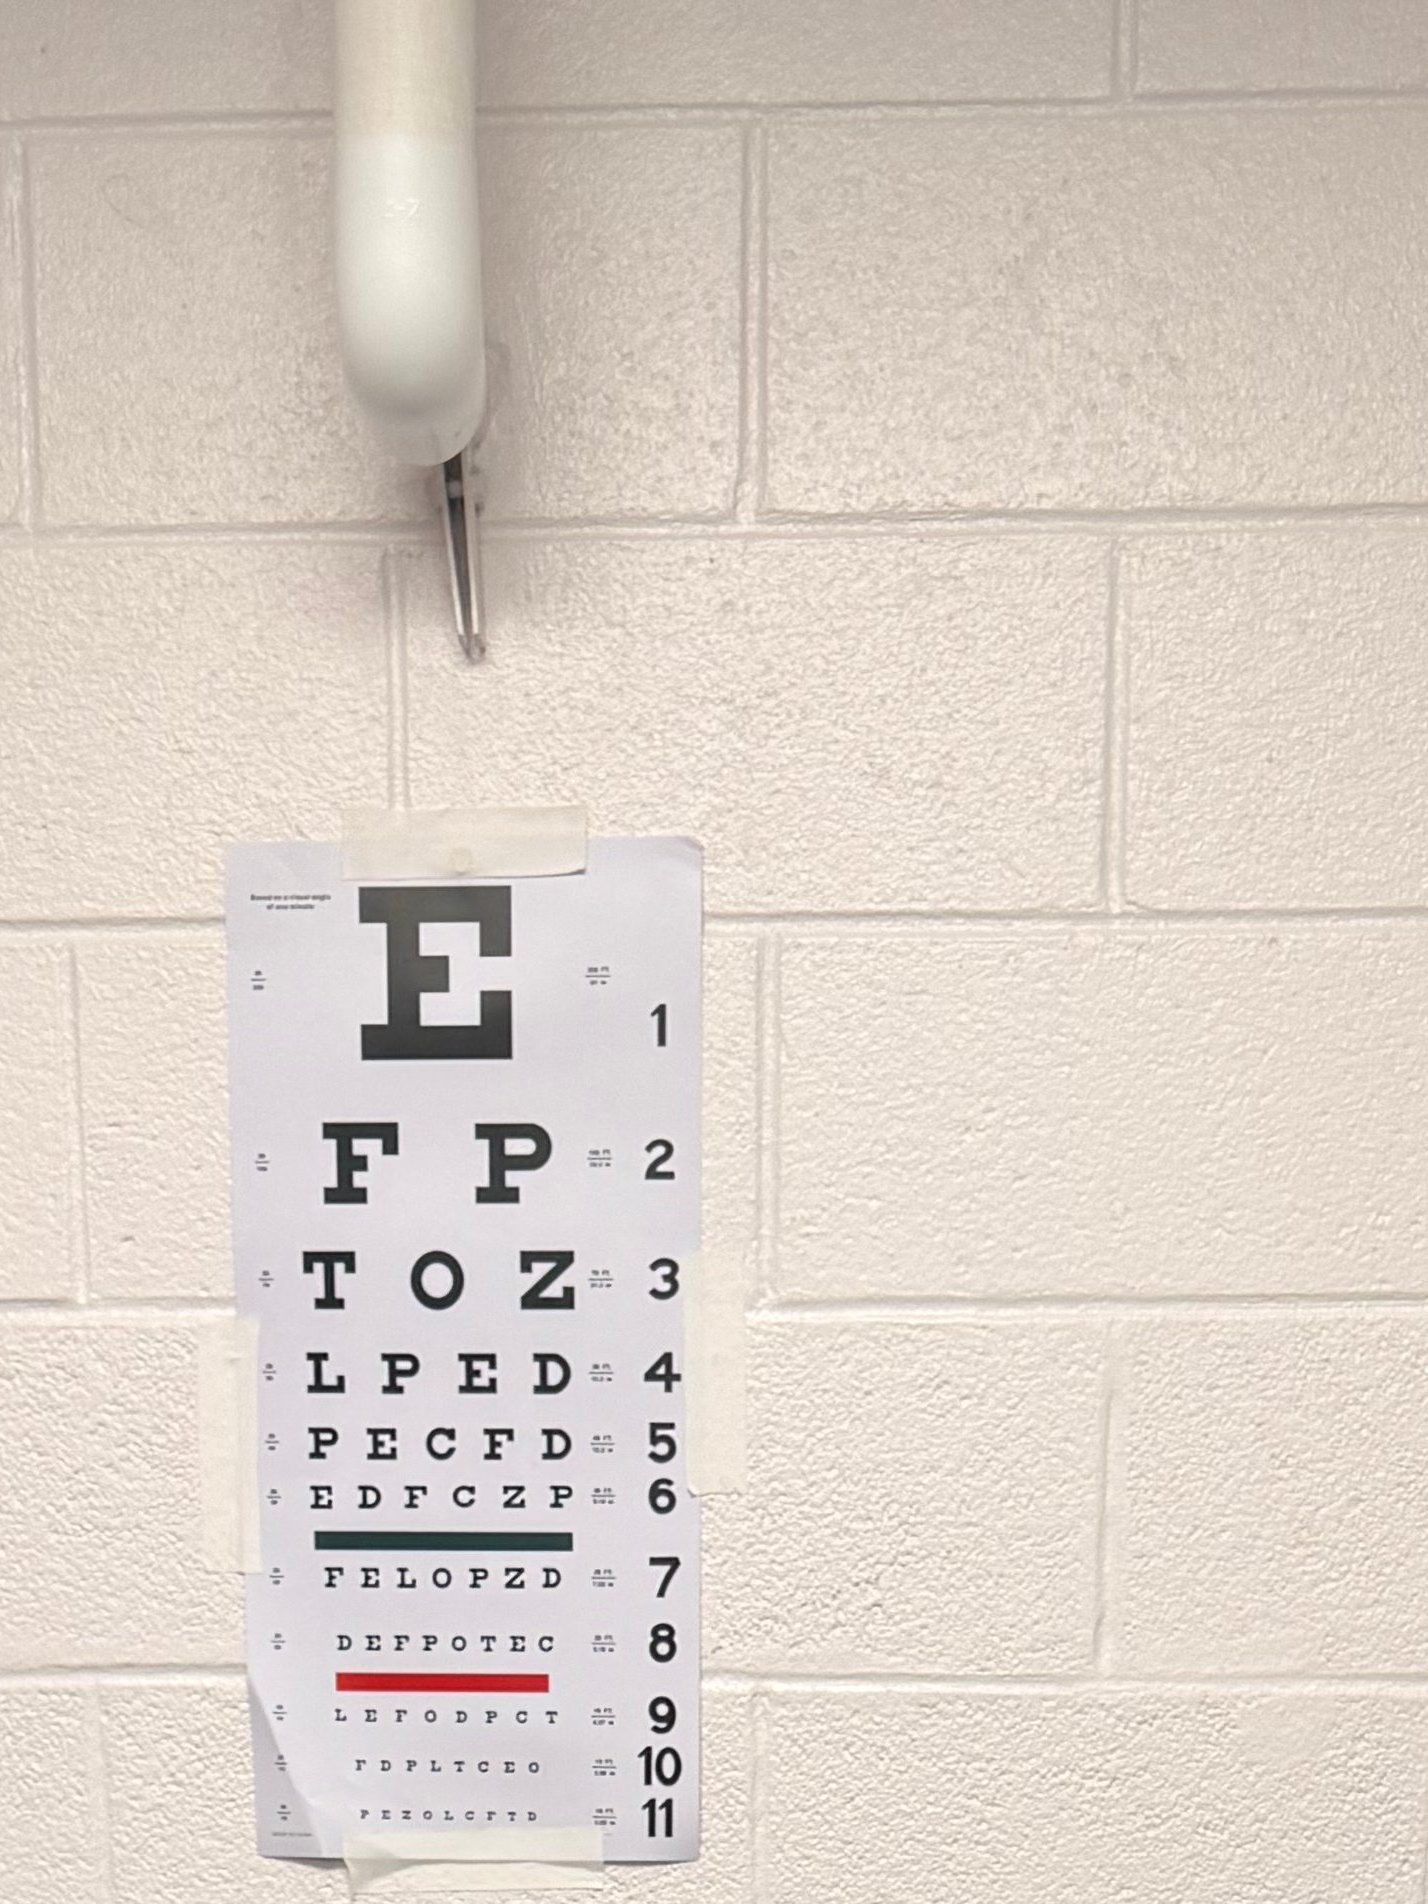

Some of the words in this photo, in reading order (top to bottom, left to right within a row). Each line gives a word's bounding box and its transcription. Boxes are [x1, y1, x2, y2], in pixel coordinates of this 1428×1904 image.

[358, 884, 514, 1062] E
[650, 1003, 667, 1048] 1
[644, 1138, 676, 1181] 2
[648, 1257, 680, 1301] 3
[643, 1351, 682, 1394] 4
[647, 1421, 677, 1464] 5
[648, 1477, 677, 1515] 6
[648, 1556, 682, 1599] 7
[648, 1622, 678, 1664] 8
[648, 1695, 677, 1735] 9
[637, 1745, 683, 1787] 10
[641, 1797, 674, 1838] 11
